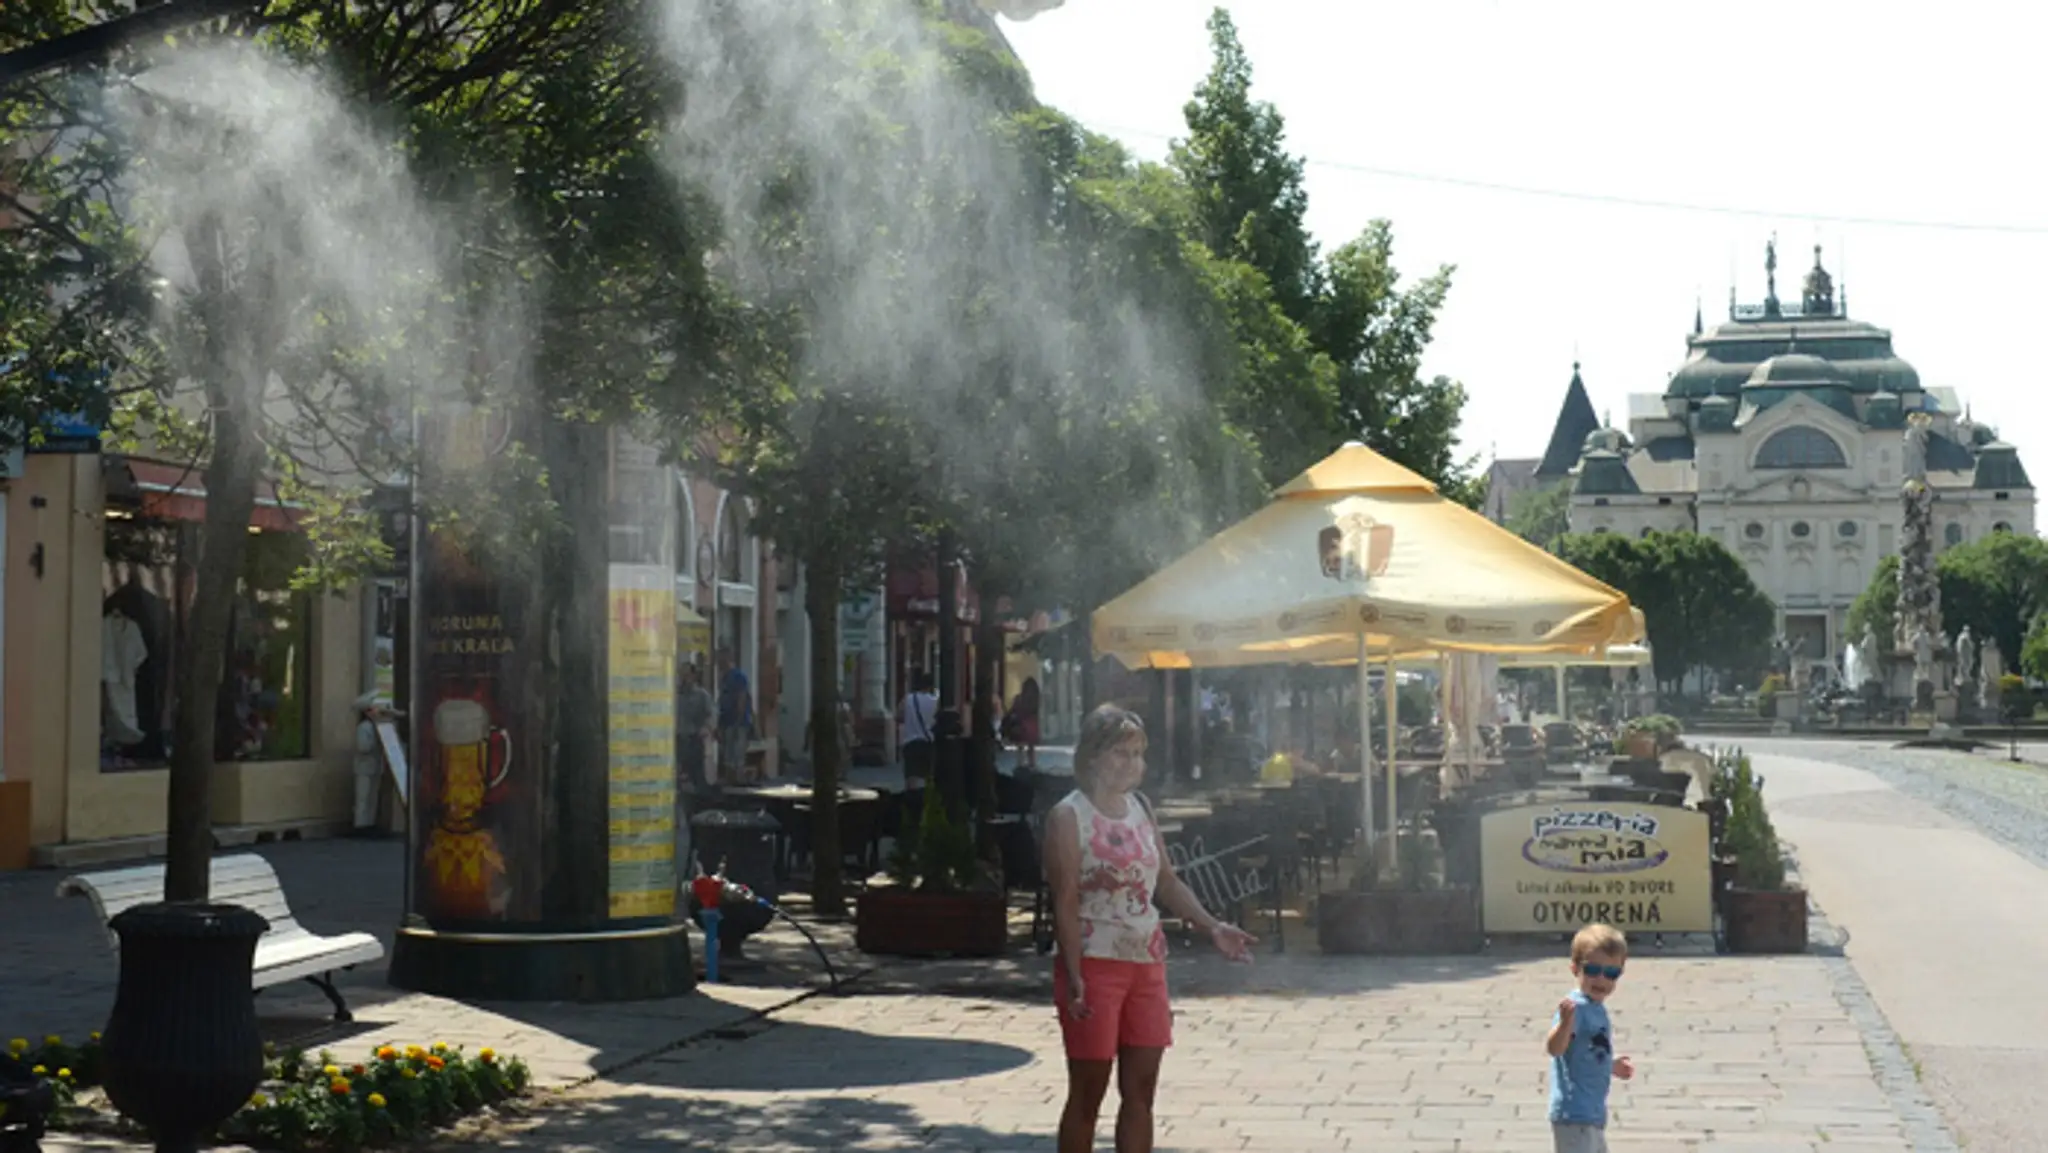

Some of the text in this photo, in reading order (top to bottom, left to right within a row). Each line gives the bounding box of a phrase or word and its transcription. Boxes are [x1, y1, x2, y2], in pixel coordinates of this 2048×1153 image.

[428, 615, 503, 632] ORUNA
[1534, 807, 1657, 837] pizzeria
[1581, 837, 1646, 864] mia
[1533, 896, 1662, 924] OTVORENÁ
